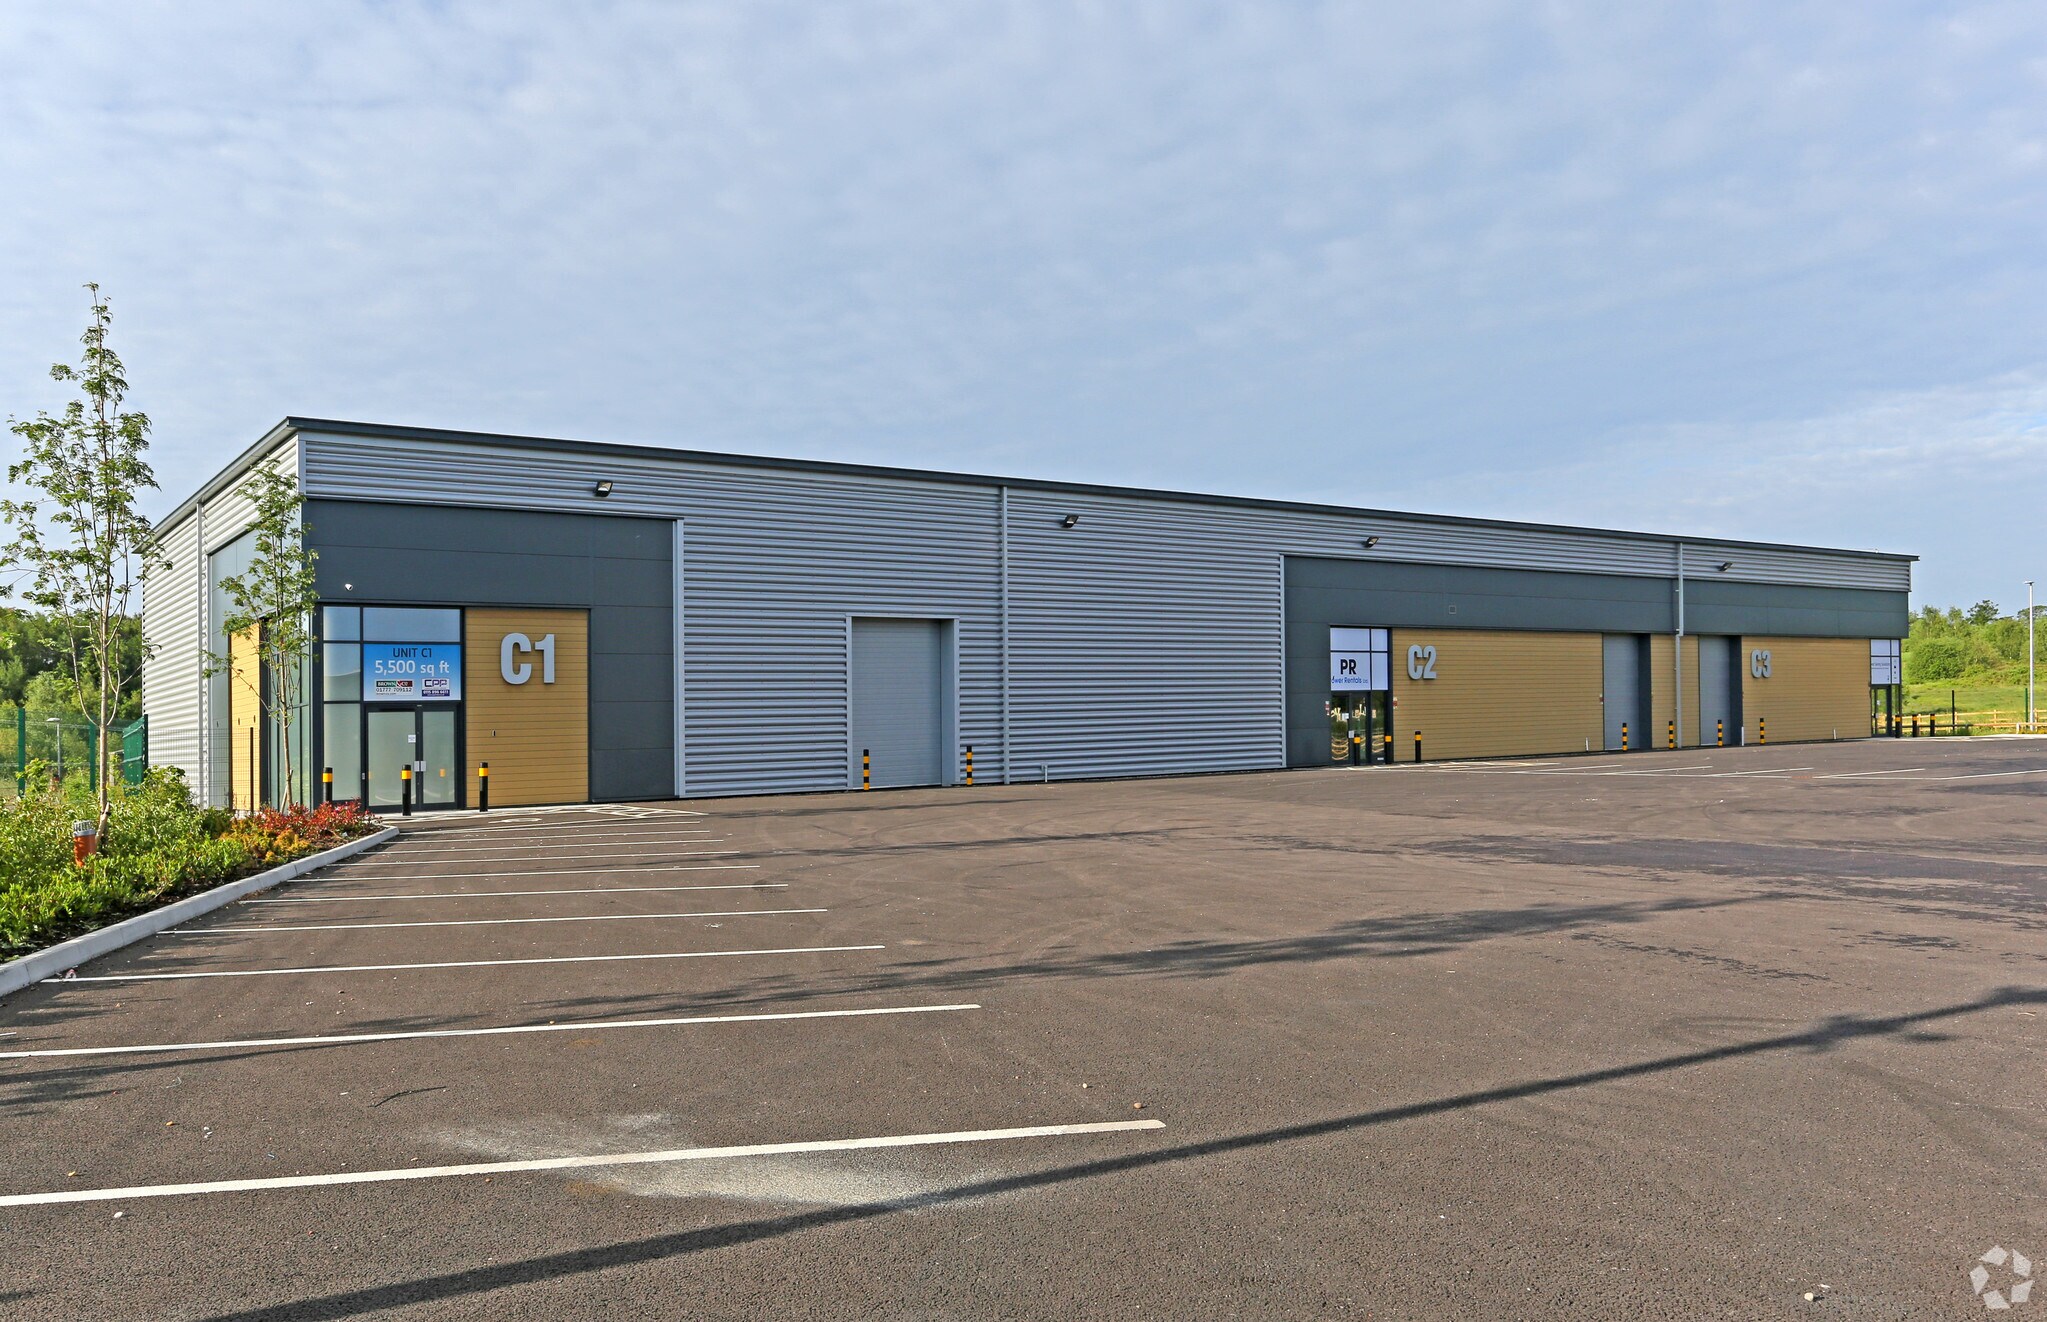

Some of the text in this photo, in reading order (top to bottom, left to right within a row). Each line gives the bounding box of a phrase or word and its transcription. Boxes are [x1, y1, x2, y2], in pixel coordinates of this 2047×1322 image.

[393, 648, 432, 657] UNIT C1
[500, 632, 555, 685] C1
[1407, 644, 1437, 680] C2
[1751, 649, 1772, 678] C3
[375, 660, 450, 677] 5,500 sq ft
[1340, 658, 1357, 675] PR
